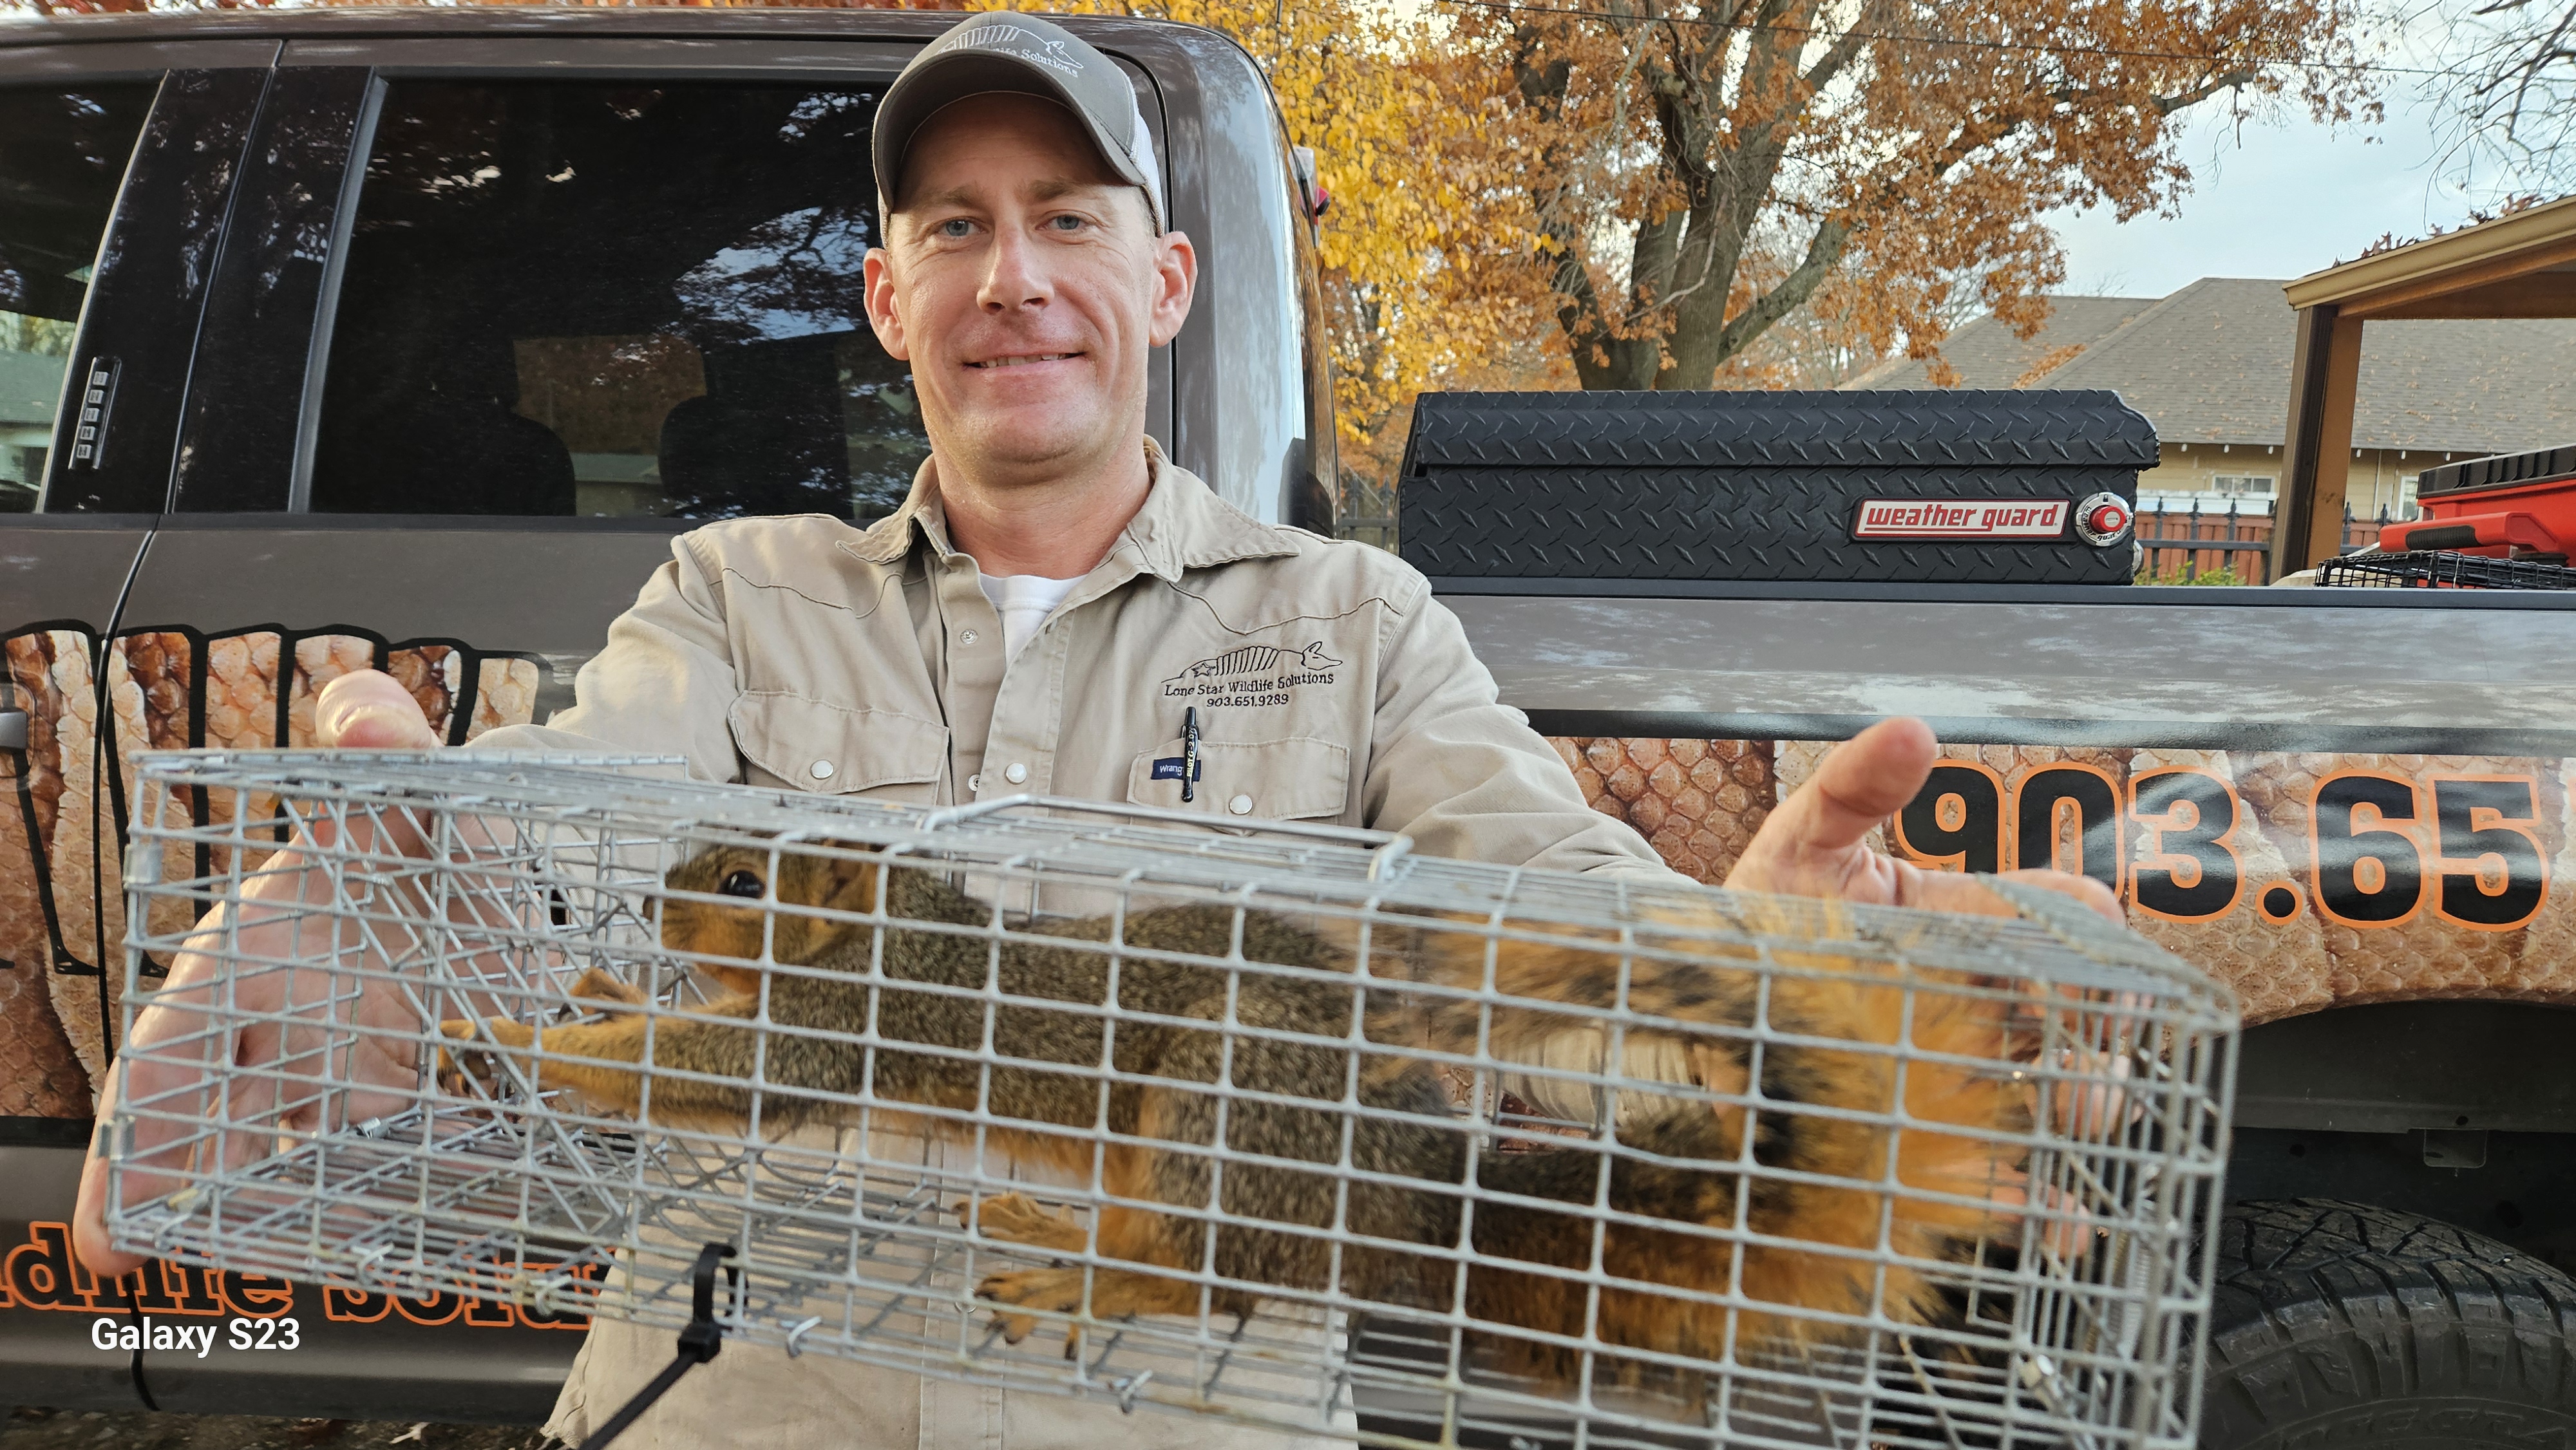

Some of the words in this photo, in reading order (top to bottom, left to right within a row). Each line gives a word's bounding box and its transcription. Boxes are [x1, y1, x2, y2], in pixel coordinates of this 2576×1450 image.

[1021, 48, 1079, 78] Solutions
[1866, 504, 1978, 526] weather
[1981, 504, 2059, 532] guard
[1164, 684, 1195, 697] Lone
[1197, 684, 1224, 695] Star
[1227, 679, 1274, 693] Wildlife
[1278, 672, 1334, 689] Solutions
[1206, 693, 1289, 707] 903.651.9289
[1160, 764, 1184, 777] Wrang
[1893, 760, 2576, 933] 903.65
